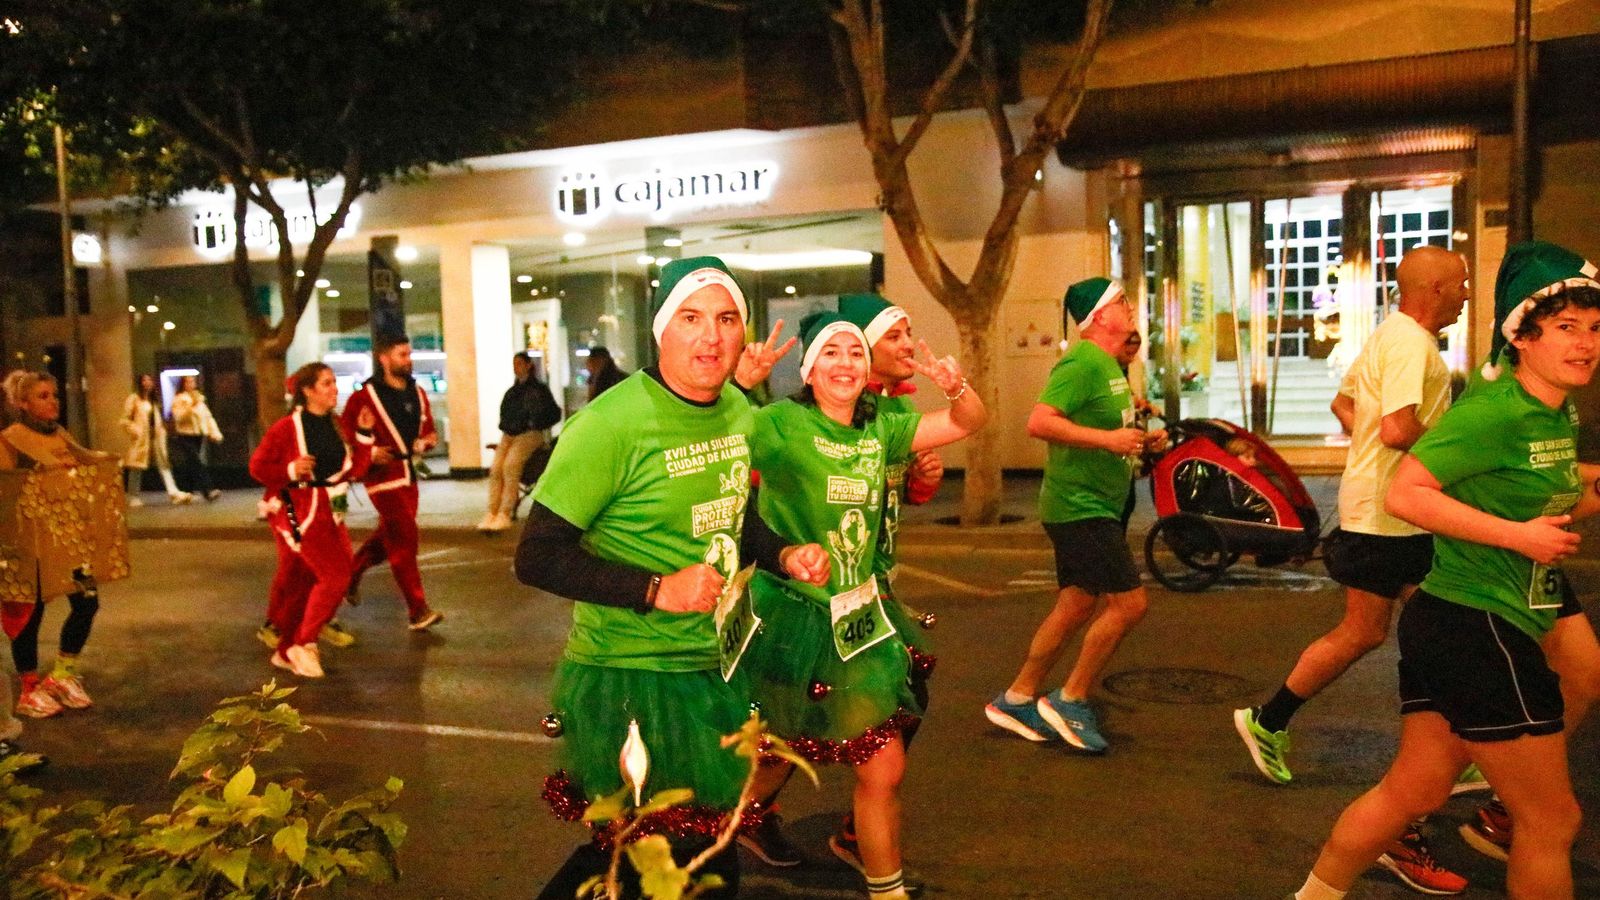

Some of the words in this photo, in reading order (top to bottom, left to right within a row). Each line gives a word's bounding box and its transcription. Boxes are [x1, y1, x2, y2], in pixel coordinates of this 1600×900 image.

[615, 168, 767, 211] cajamar
[664, 447, 687, 461] XVII
[689, 441, 709, 456] SAN
[666, 456, 705, 473] CIUDAD
[707, 451, 719, 464] DE
[695, 506, 734, 525] PROTEG
[843, 611, 875, 644] 405
